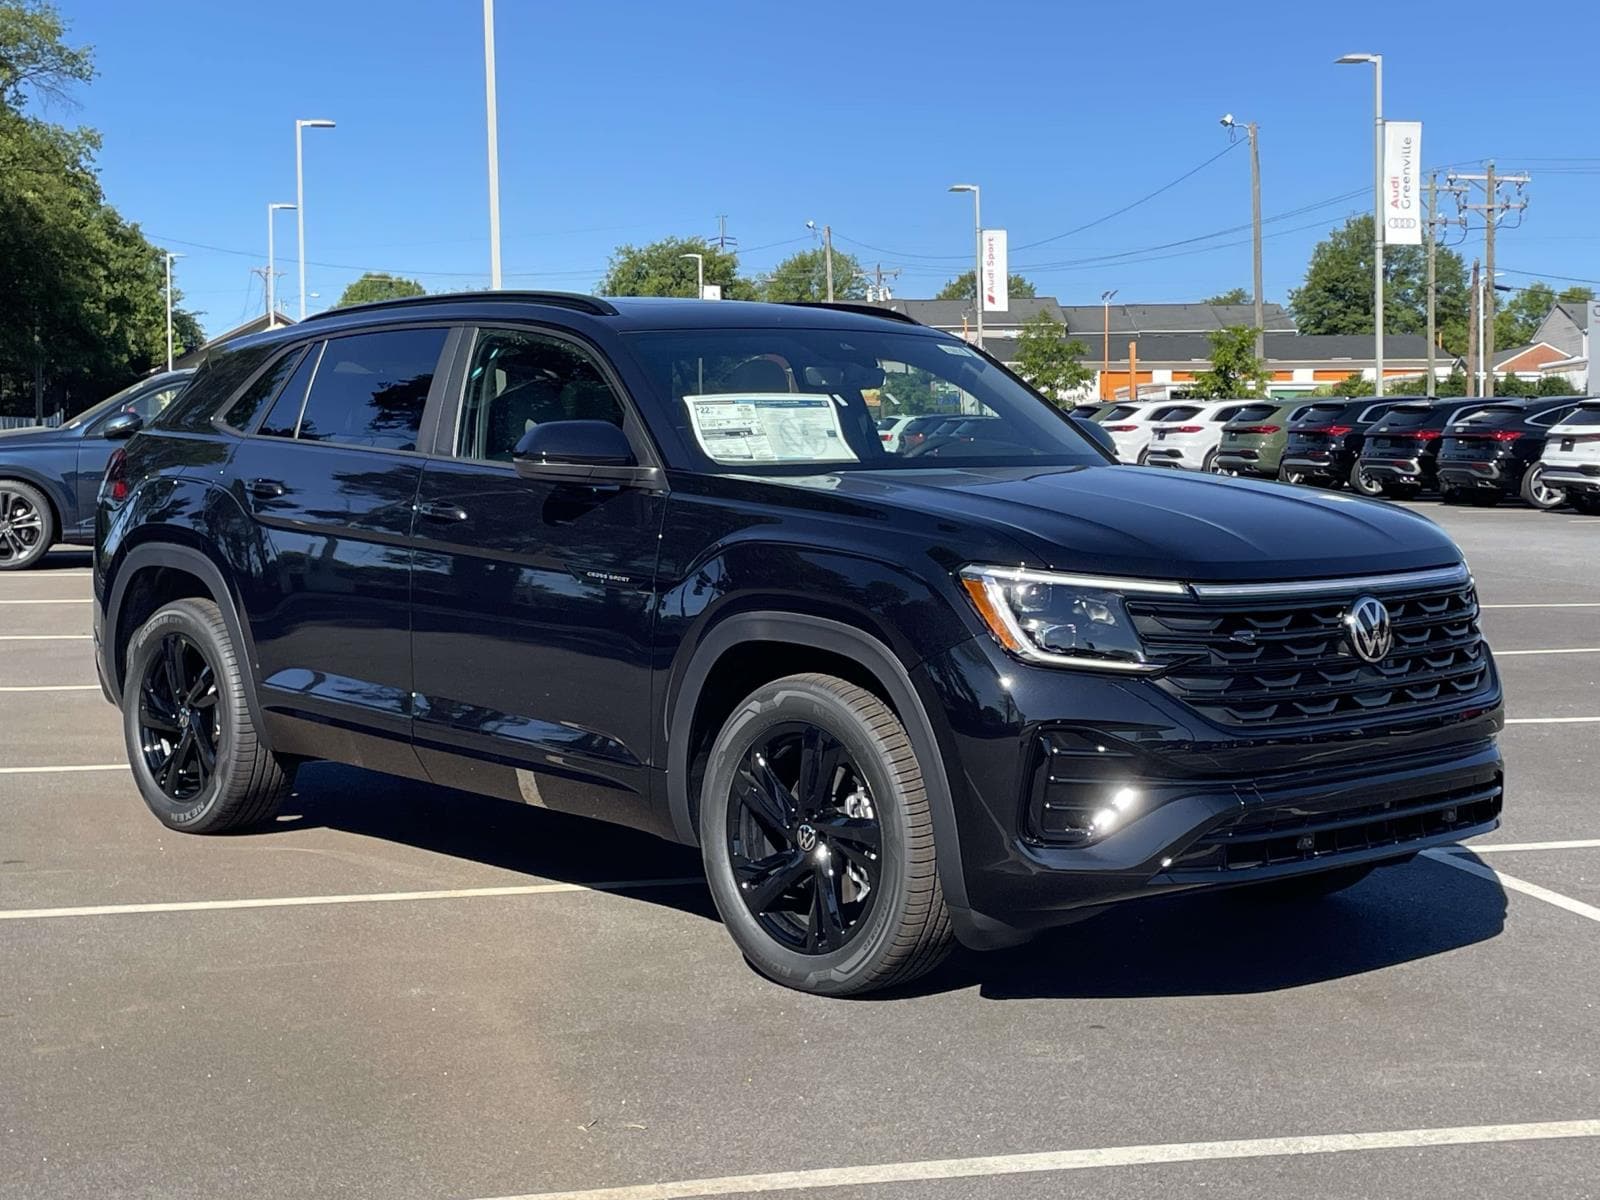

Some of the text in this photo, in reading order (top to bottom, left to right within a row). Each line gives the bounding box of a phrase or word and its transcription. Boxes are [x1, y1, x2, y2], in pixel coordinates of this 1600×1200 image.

[1390, 176, 1400, 209] Audi
[1401, 137, 1412, 210] Greenville
[987, 237, 996, 294] Audi Sport
[1350, 597, 1392, 663] VW
